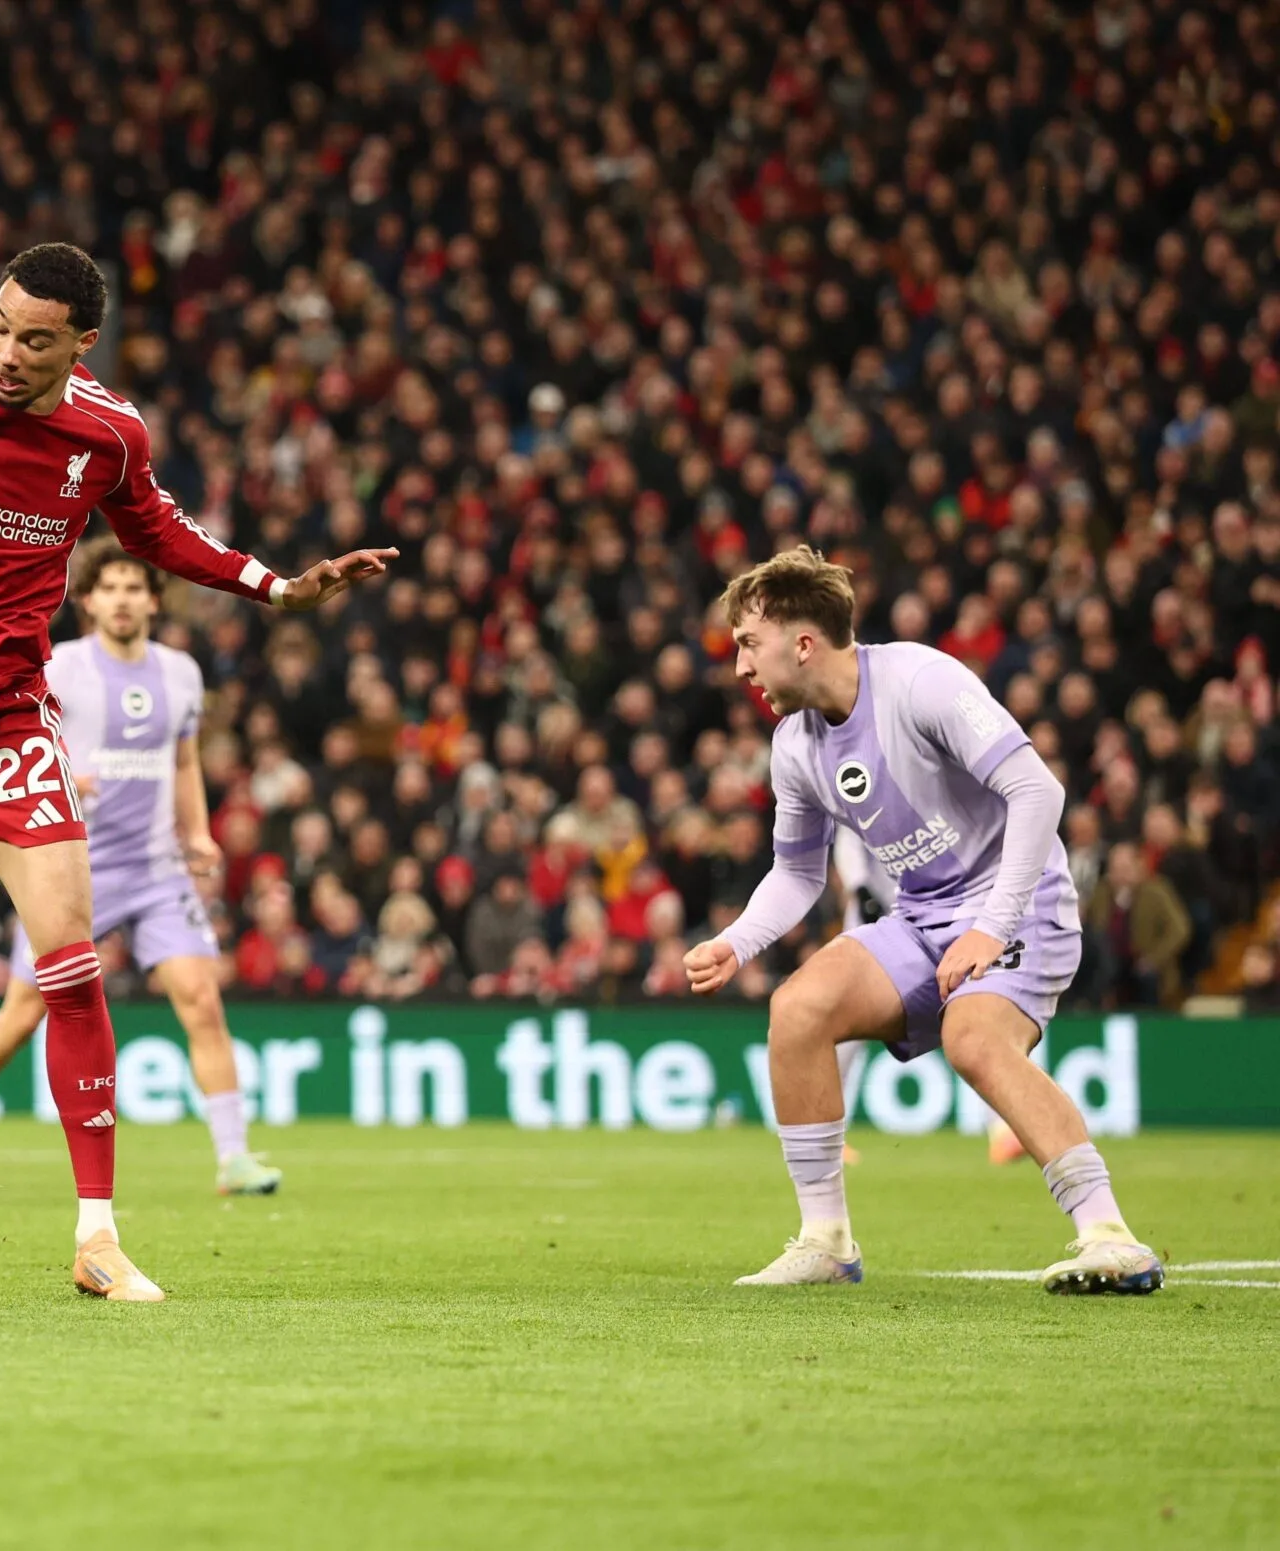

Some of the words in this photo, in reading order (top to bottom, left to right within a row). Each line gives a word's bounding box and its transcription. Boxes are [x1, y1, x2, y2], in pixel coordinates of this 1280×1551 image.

[870, 814, 947, 862] ERICAN
[348, 1005, 469, 1127] in
[495, 1008, 716, 1132] the
